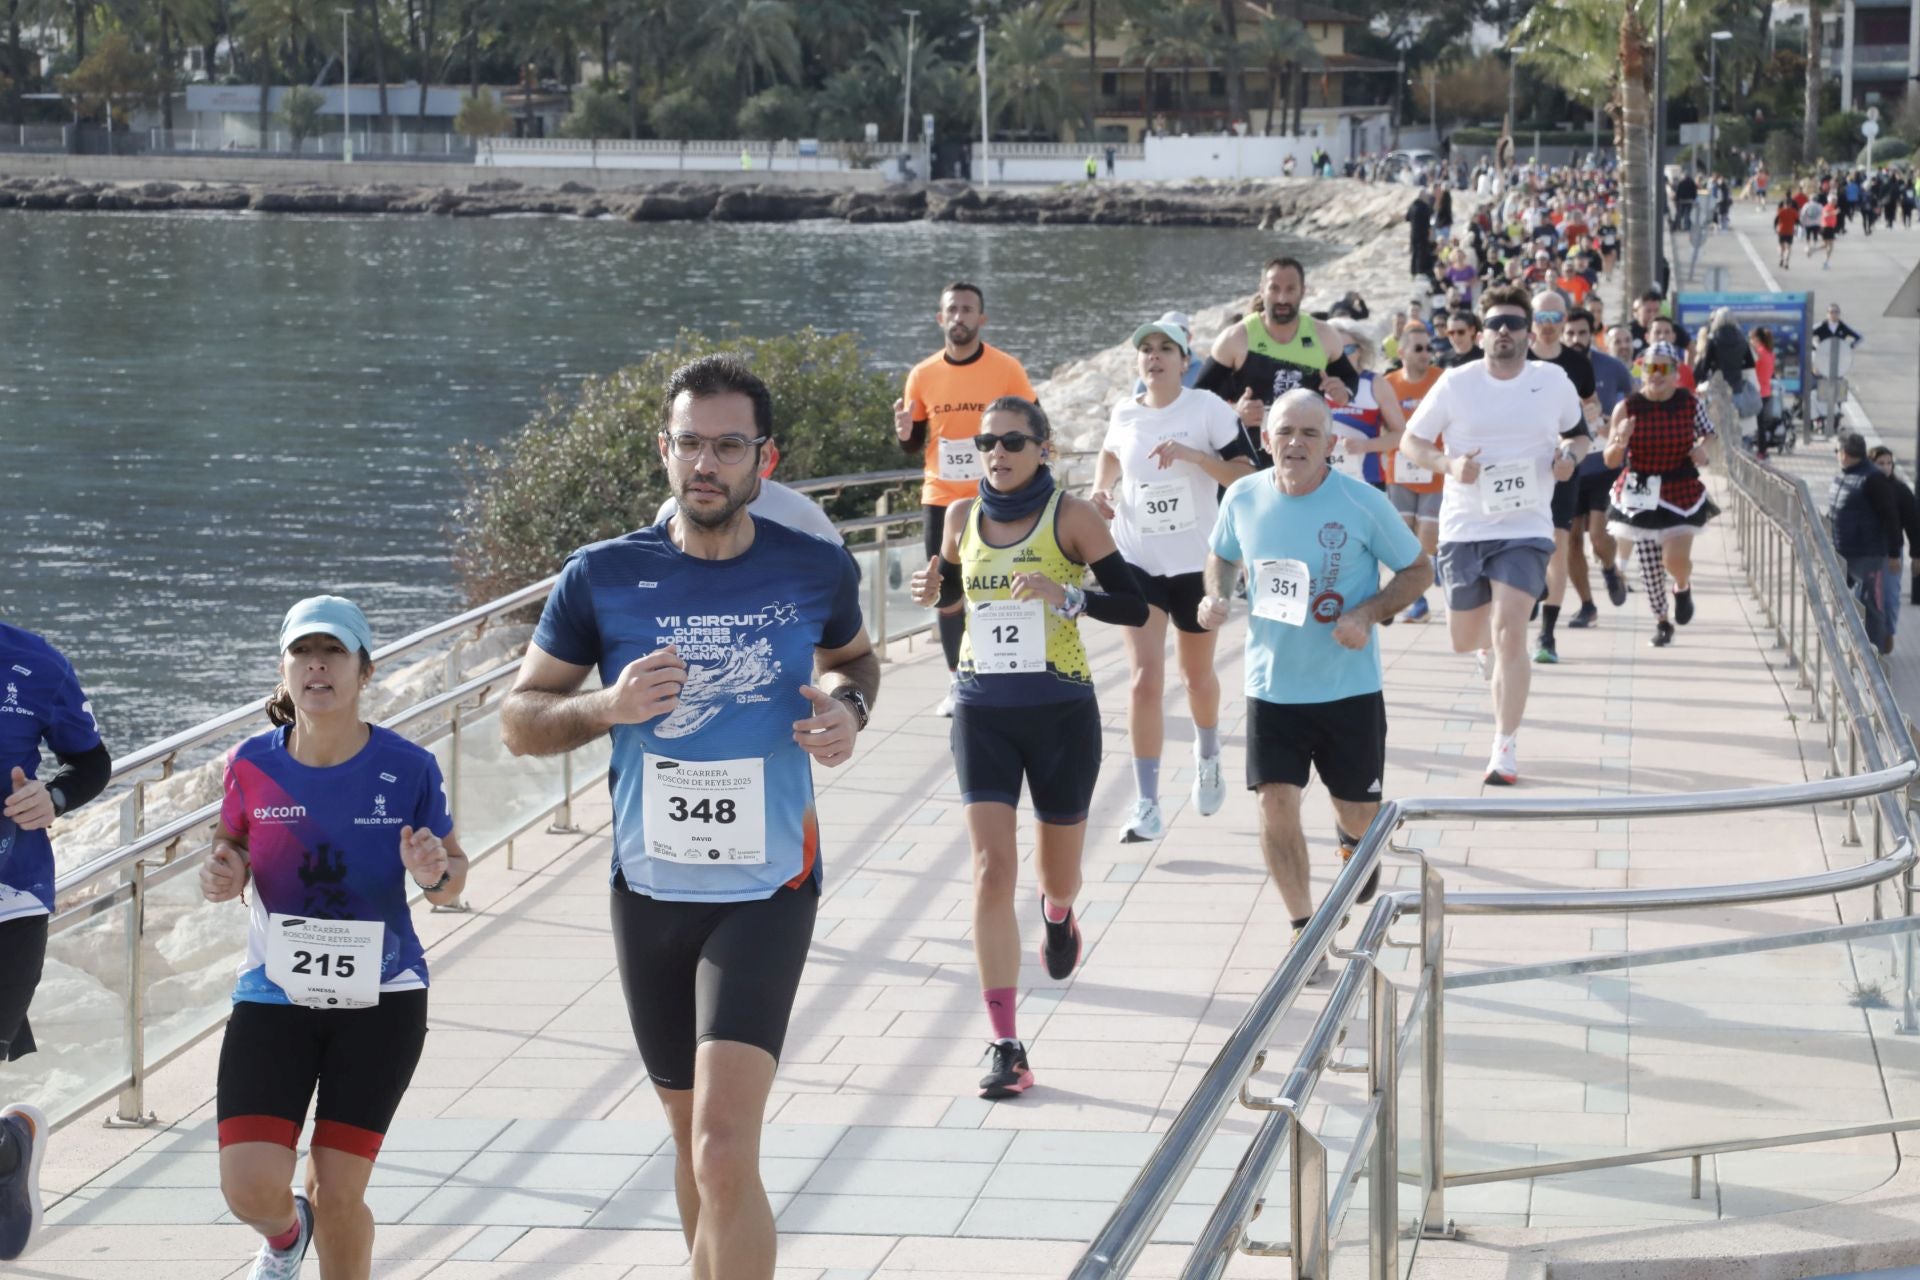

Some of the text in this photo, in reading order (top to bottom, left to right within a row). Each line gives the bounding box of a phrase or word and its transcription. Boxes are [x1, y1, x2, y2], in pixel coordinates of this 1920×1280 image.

[934, 403, 985, 414] C.D.JAVE
[946, 453, 974, 464] 352
[1494, 476, 1525, 493] 276
[1146, 498, 1179, 515] 307
[966, 575, 1014, 590] BALEA
[1271, 578, 1298, 598] 351
[656, 615, 767, 628] VII CIRCUIT
[657, 636, 730, 645] POPULARS
[991, 625, 1019, 644] 12
[676, 768, 728, 777] XI CARRERA
[691, 778, 702, 786] DE
[704, 778, 732, 786] REYES
[733, 777, 752, 785] 2025
[253, 804, 306, 819] excom
[668, 797, 736, 824] 348
[354, 817, 403, 825] MILLOR GRUP
[312, 924, 350, 934] CARRERA
[292, 950, 355, 978] 215
